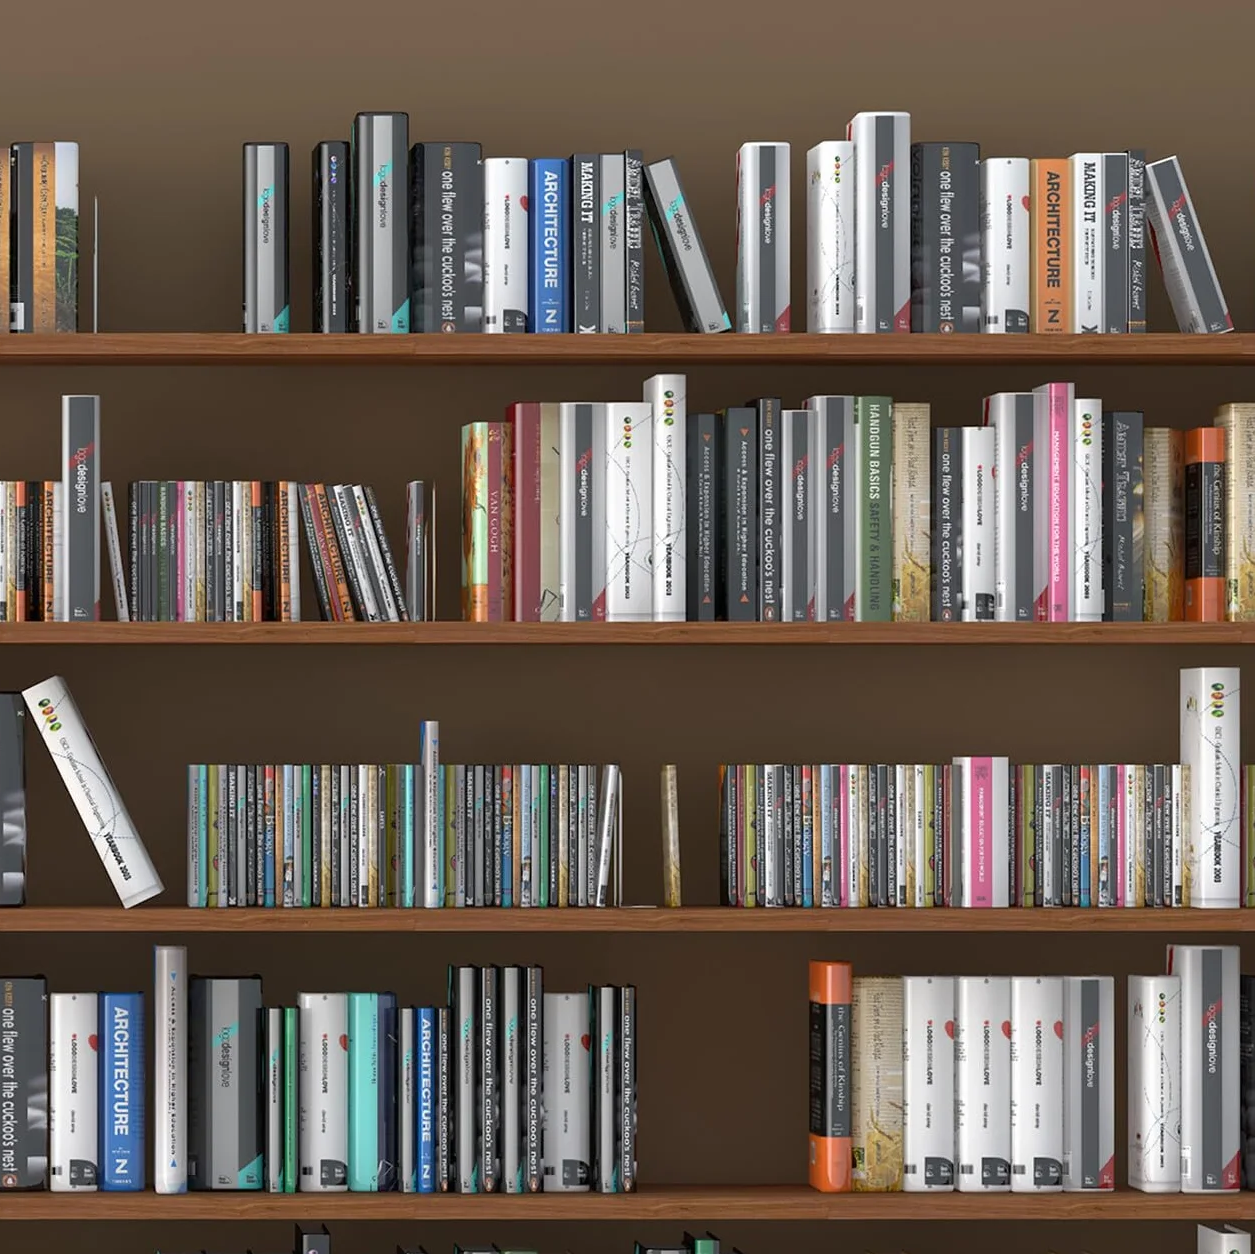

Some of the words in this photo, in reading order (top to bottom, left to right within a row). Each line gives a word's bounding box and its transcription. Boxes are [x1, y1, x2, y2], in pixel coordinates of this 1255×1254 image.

[442, 171, 453, 190] one
[581, 162, 593, 208] MAKING
[1084, 162, 1096, 208] MAKING
[442, 192, 456, 212] flew
[441, 214, 453, 235] over
[581, 211, 593, 223] IT
[1084, 211, 1096, 223] IT
[544, 171, 558, 288] ARCHITECTURE
[1047, 171, 1060, 288] ARCHITECTURE
[442, 238, 456, 253] the
[442, 256, 456, 297] cuckoo's
[442, 300, 456, 320] nest
[765, 429, 773, 451] one
[869, 404, 880, 457] HANDGUN
[765, 453, 775, 477] flew
[764, 479, 773, 504] over
[869, 460, 880, 499] BASICS
[490, 491, 498, 514] VAN
[764, 508, 775, 525] the
[870, 502, 880, 541] SAFETY
[490, 518, 498, 552] GOGH
[765, 528, 775, 577] cuckoo's
[765, 580, 775, 603] nest
[870, 556, 880, 610] HANDLING
[2, 1008, 14, 1028] one
[2, 1031, 18, 1053] flew
[2, 1055, 14, 1079] over
[113, 1007, 129, 1135] ARCHITECTURE
[2, 1082, 18, 1098] the
[422, 1017, 430, 1142] ARCHITECTURE
[2, 1101, 18, 1146] cuckoo's
[2, 1150, 18, 1172] nest
